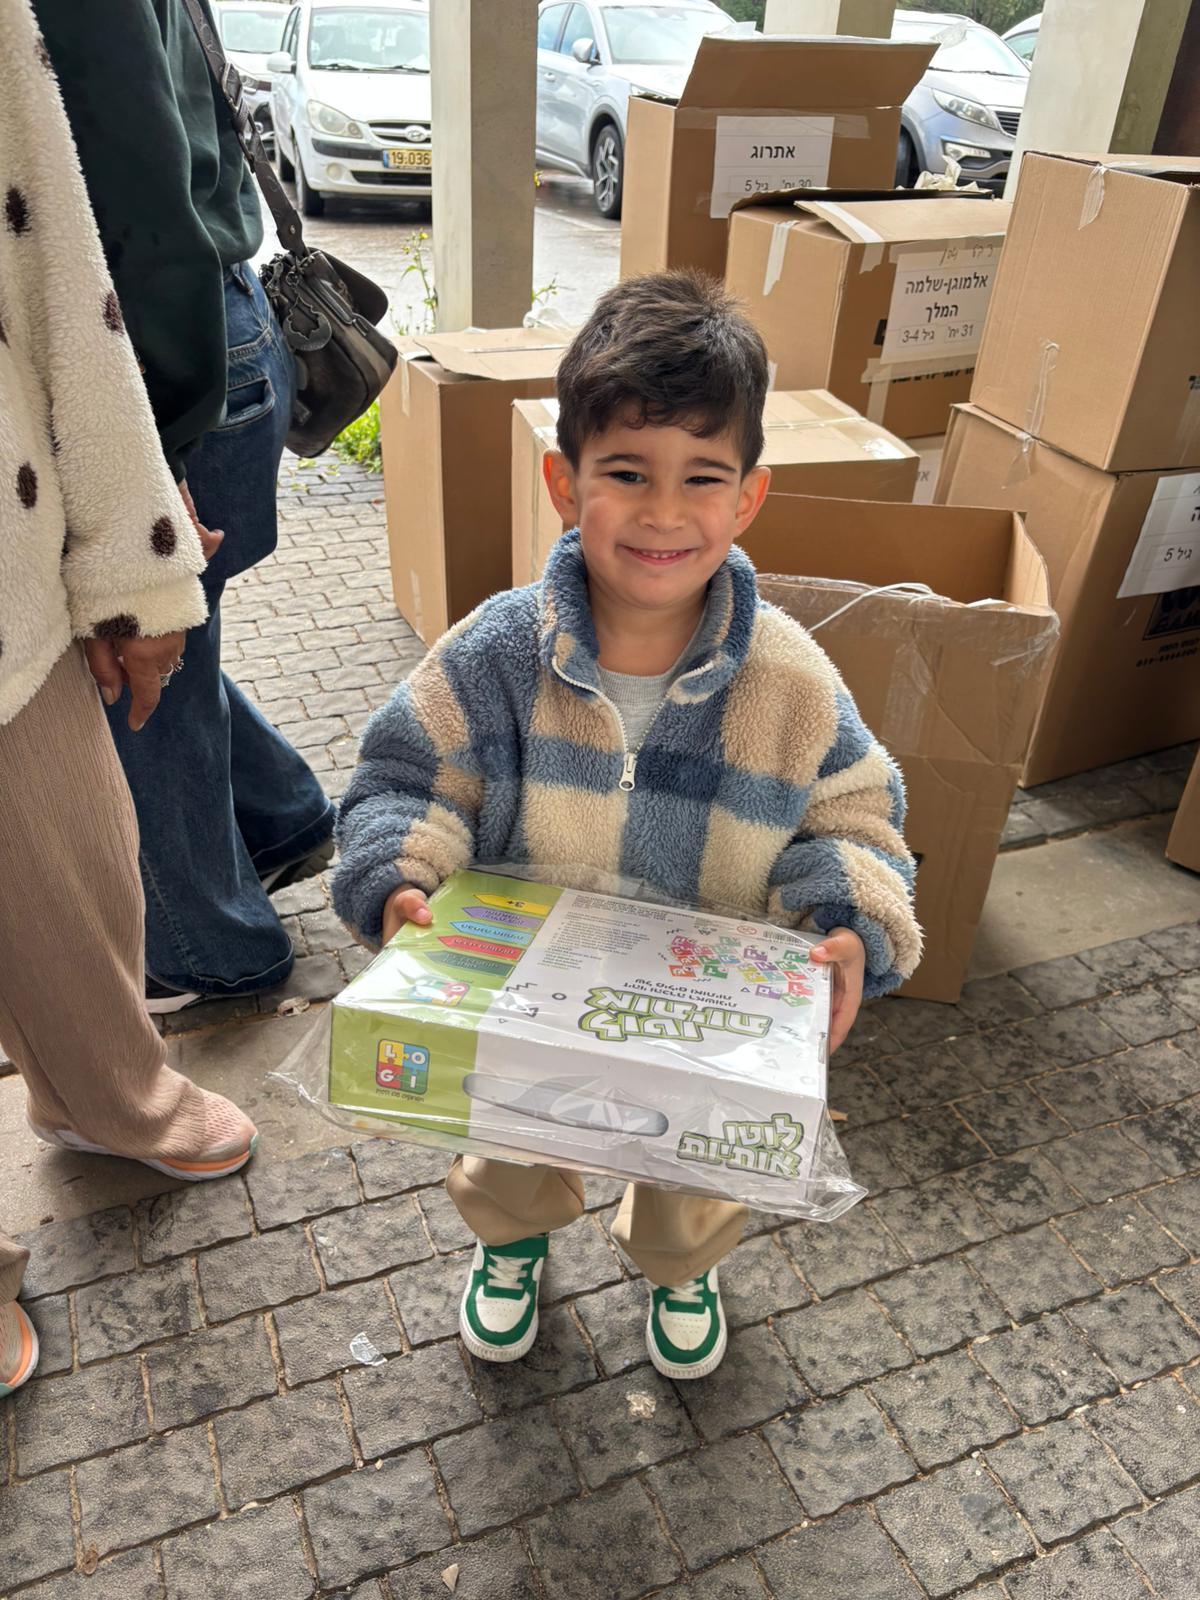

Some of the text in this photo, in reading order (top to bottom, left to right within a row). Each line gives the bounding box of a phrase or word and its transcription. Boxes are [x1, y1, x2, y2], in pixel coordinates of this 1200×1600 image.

[750, 145, 796, 159] אתרוג
[744, 179, 753, 192] 5
[755, 179, 769, 191] גיל
[905, 271, 989, 295] אלמוגן-שלמה
[925, 301, 959, 323] המלך
[902, 328, 920, 343] 3-4
[921, 328, 935, 341] גיל
[960, 323, 974, 337] 31
[1163, 547, 1193, 562] גיל 5
[507, 900, 525, 908] 3+
[623, 982, 738, 1008] זיהוי והכרה ראשונית
[635, 978, 733, 1001] של מילים ואותיות
[584, 986, 774, 1038] אותיות
[578, 1009, 703, 1042] לוטו
[722, 1112, 805, 1152] לוטו
[676, 1130, 803, 1180] אותיות
